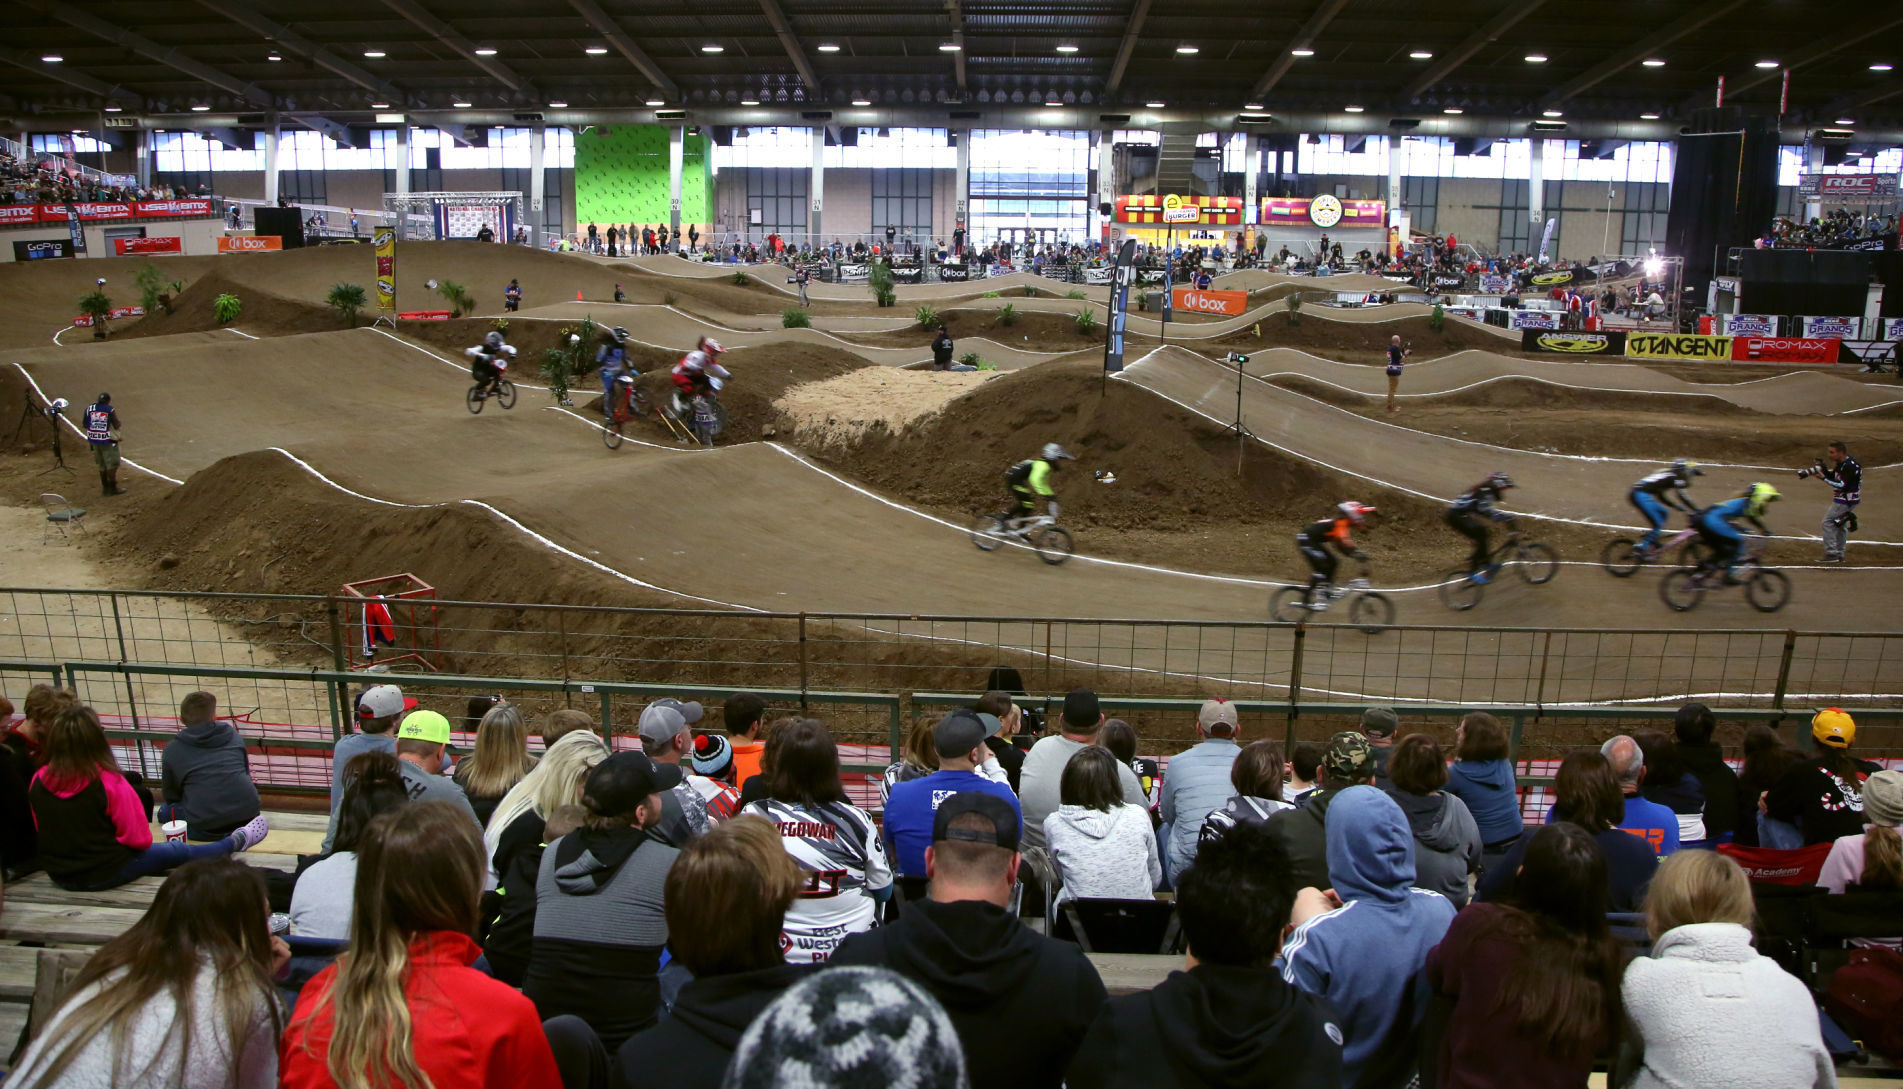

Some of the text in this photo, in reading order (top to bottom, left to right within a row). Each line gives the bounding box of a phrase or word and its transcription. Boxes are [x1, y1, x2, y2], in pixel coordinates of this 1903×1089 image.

[138, 203, 168, 211] USA
[28, 242, 63, 251] GoPro
[243, 237, 267, 249] box
[1199, 295, 1228, 312] box
[1513, 318, 1555, 328] GRANDS
[1728, 321, 1772, 332] GRANDS
[1809, 323, 1853, 334] GRANDS
[1541, 332, 1608, 342] ANSWER
[1646, 335, 1730, 357] TANGENT
[1748, 338, 1828, 350] PROMAX
[1754, 866, 1804, 877] Academy
